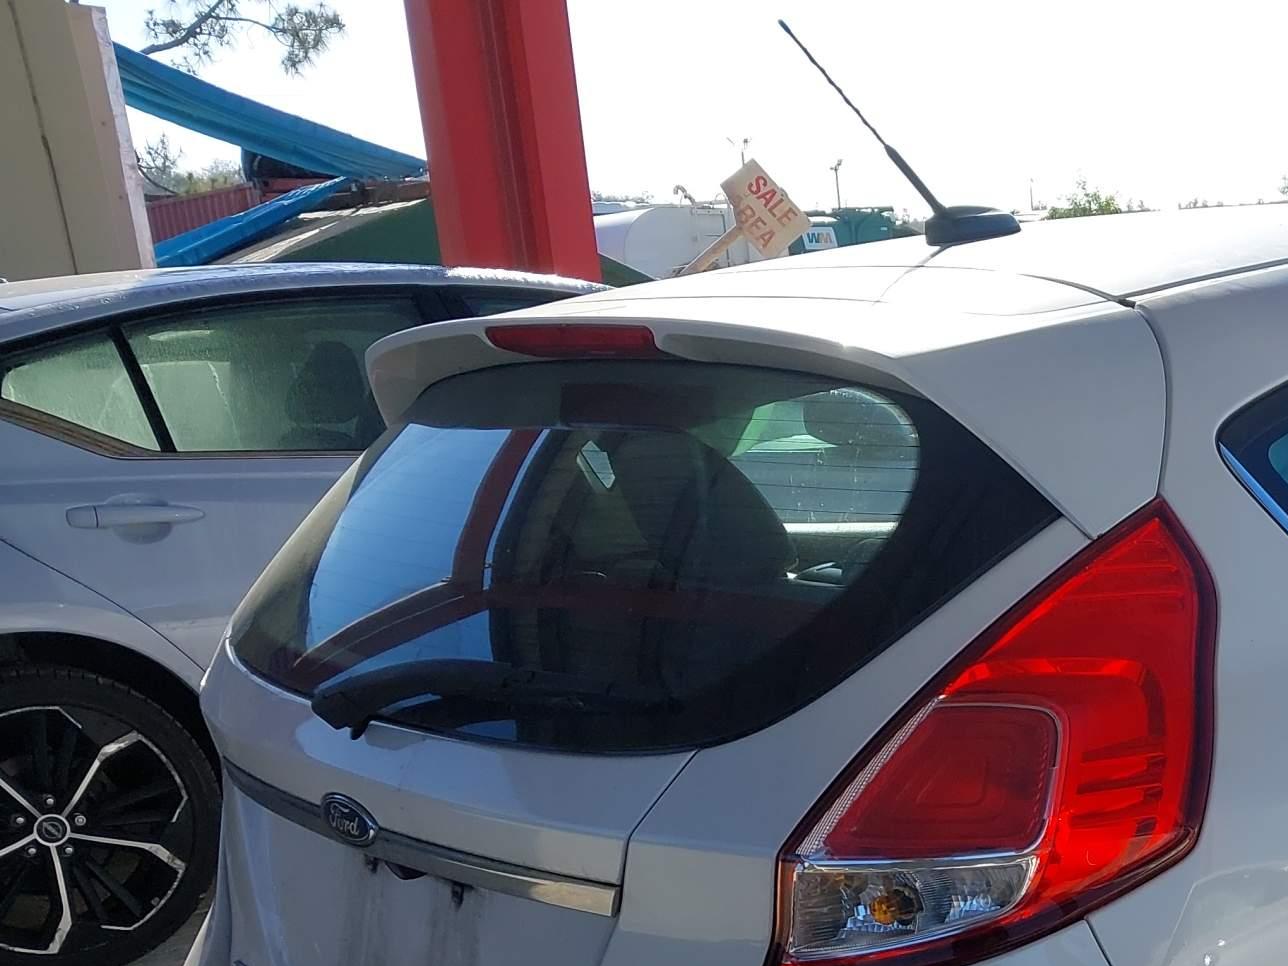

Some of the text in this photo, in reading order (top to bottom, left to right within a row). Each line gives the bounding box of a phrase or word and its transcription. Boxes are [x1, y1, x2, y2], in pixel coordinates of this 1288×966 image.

[747, 175, 798, 227] SALE
[806, 231, 833, 244] WM
[328, 802, 361, 836] Ford
